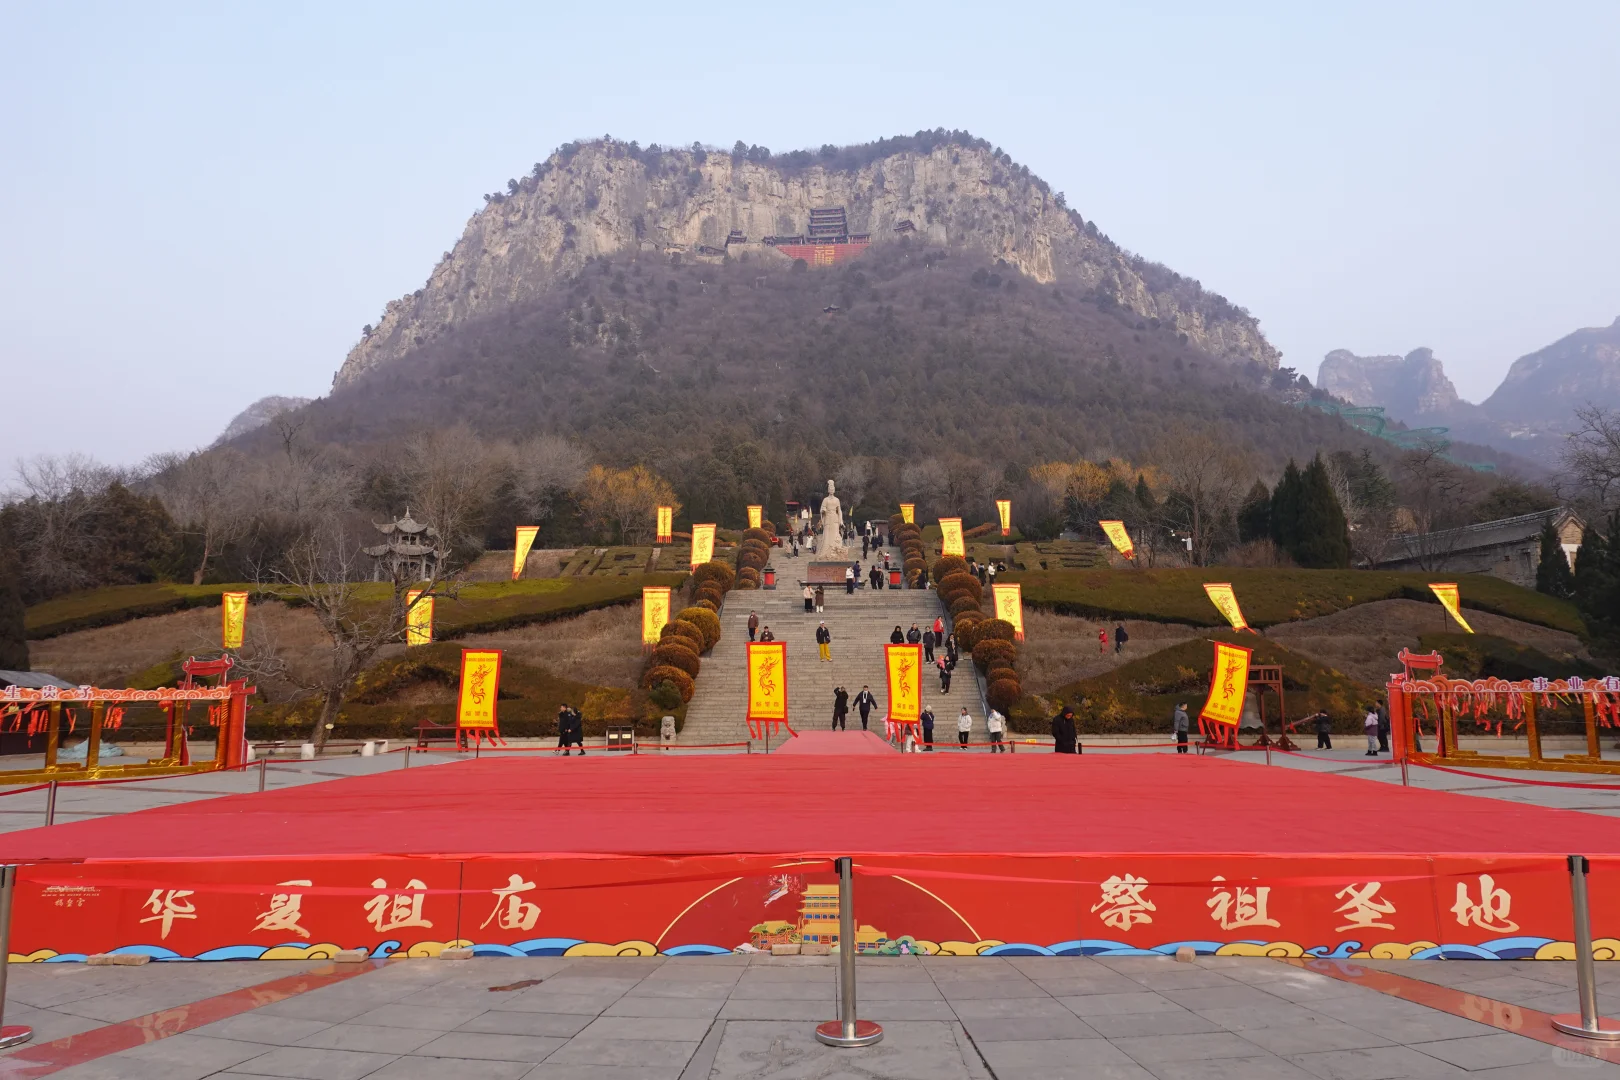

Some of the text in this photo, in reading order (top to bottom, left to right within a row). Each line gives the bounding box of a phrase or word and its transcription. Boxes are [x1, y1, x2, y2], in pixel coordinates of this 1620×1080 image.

[5, 685, 93, 700] 生贵子
[1533, 676, 1620, 691] 事业有
[140, 874, 541, 940] 华夏祖庙
[1091, 873, 1520, 933] 祭祖圣地
